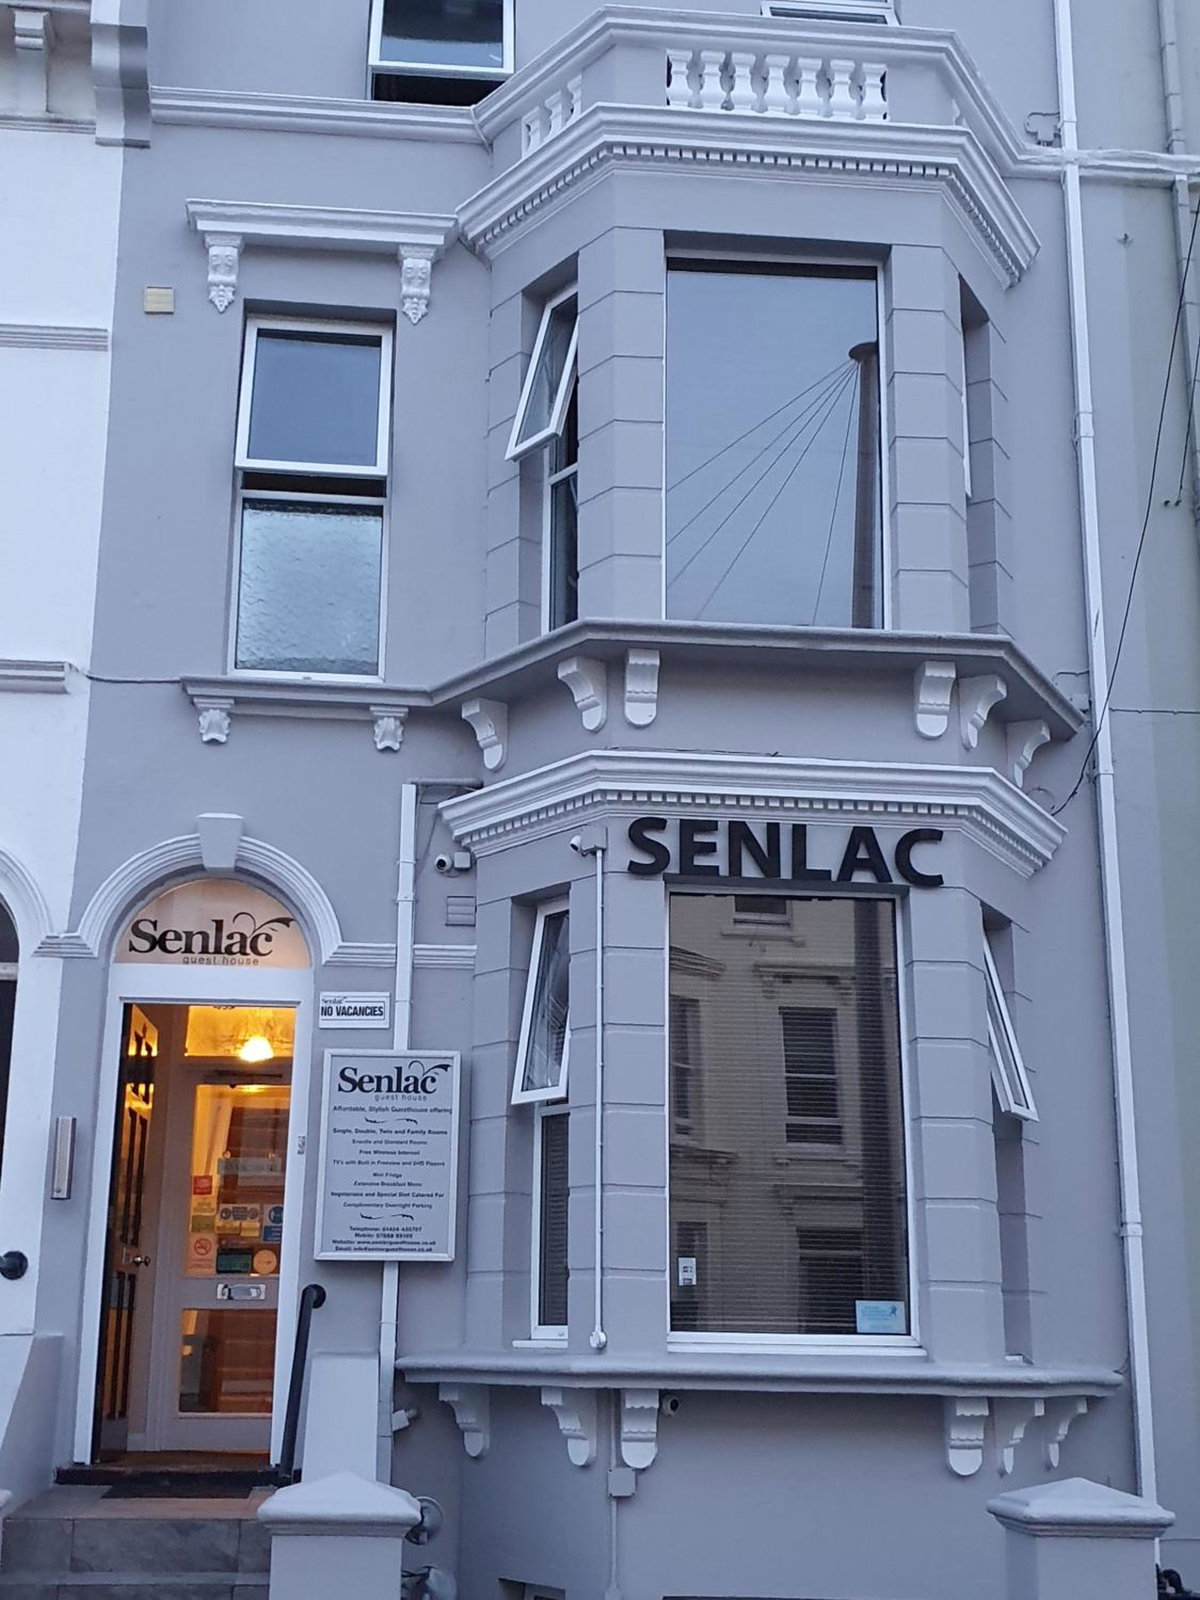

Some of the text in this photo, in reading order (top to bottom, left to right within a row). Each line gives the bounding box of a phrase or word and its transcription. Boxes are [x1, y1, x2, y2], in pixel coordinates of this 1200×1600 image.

[627, 816, 944, 888] SENLAC
[128, 918, 273, 957] Senlac
[182, 957, 260, 966] guest house
[320, 1006, 384, 1016] NO VACANCIES
[337, 1066, 437, 1094] Senlac
[374, 1094, 398, 1102] guest
